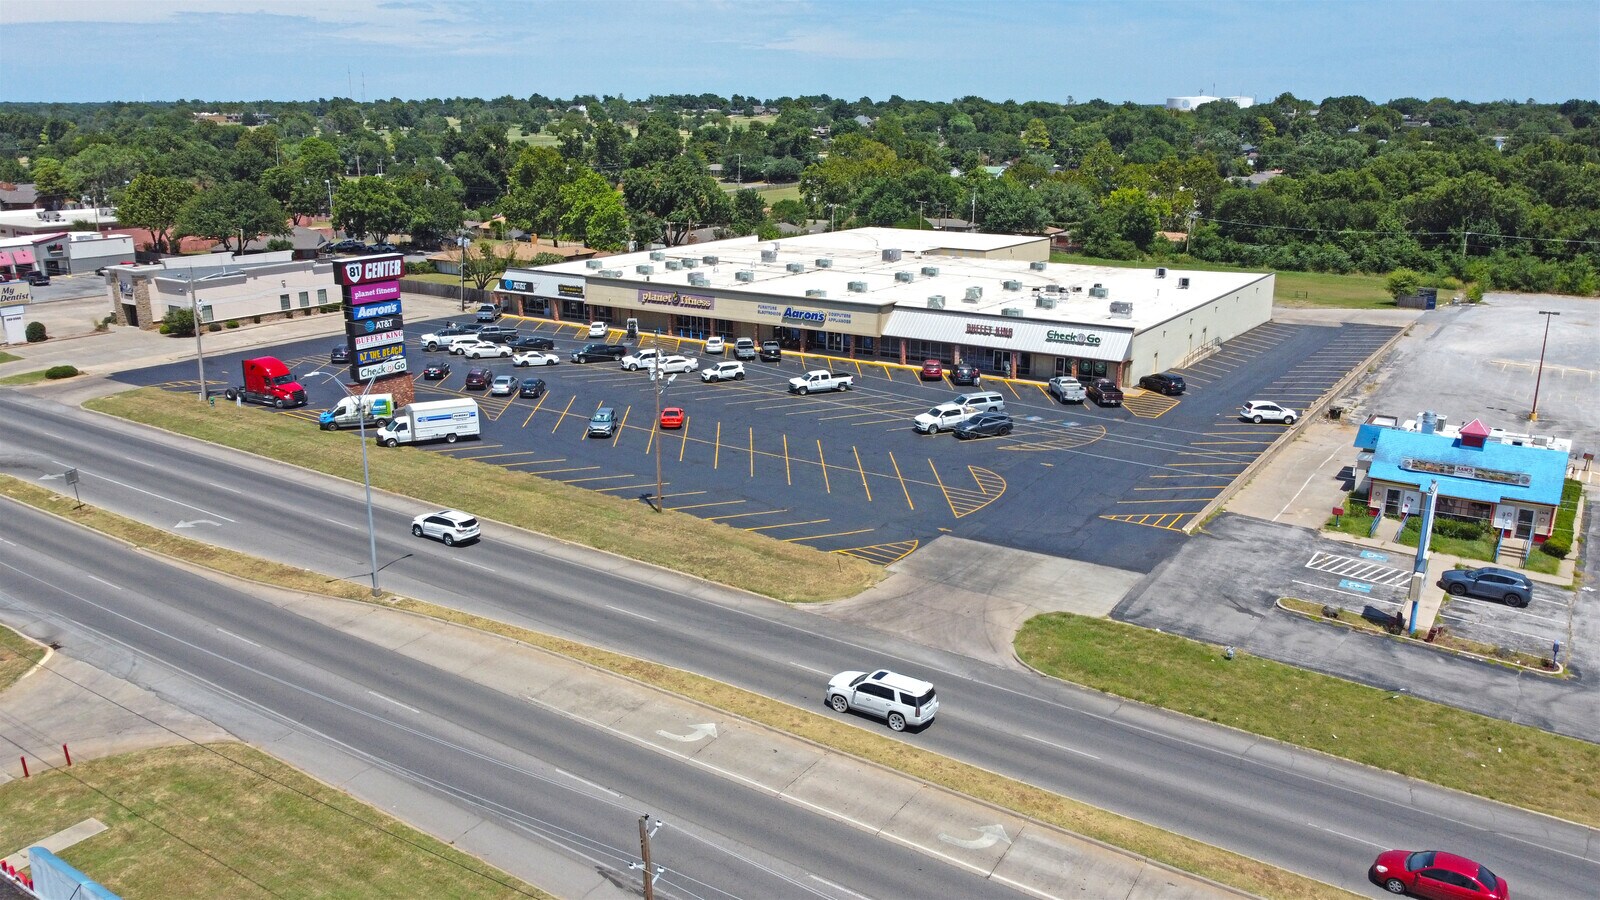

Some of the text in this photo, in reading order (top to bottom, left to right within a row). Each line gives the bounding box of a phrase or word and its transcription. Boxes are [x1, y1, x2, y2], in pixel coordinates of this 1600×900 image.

[349, 260, 401, 280] 81 CENTER
[1, 293, 29, 302] Dentist
[2, 287, 14, 295] My
[354, 286, 397, 299] planet fitness
[641, 291, 712, 308] planet fitness
[358, 304, 398, 318] Aaron's
[783, 306, 825, 322] Aaron's
[375, 319, 393, 329] AT&T
[966, 323, 1013, 336] BUFFET KING
[356, 333, 383, 344] BUFFET
[386, 330, 403, 339] KING
[1047, 330, 1077, 341] Check
[1087, 334, 1101, 343] Go
[359, 351, 368, 361] AT
[369, 350, 381, 359] THE
[382, 345, 403, 357] BEACH
[361, 365, 386, 377] Check
[394, 361, 406, 370] Go
